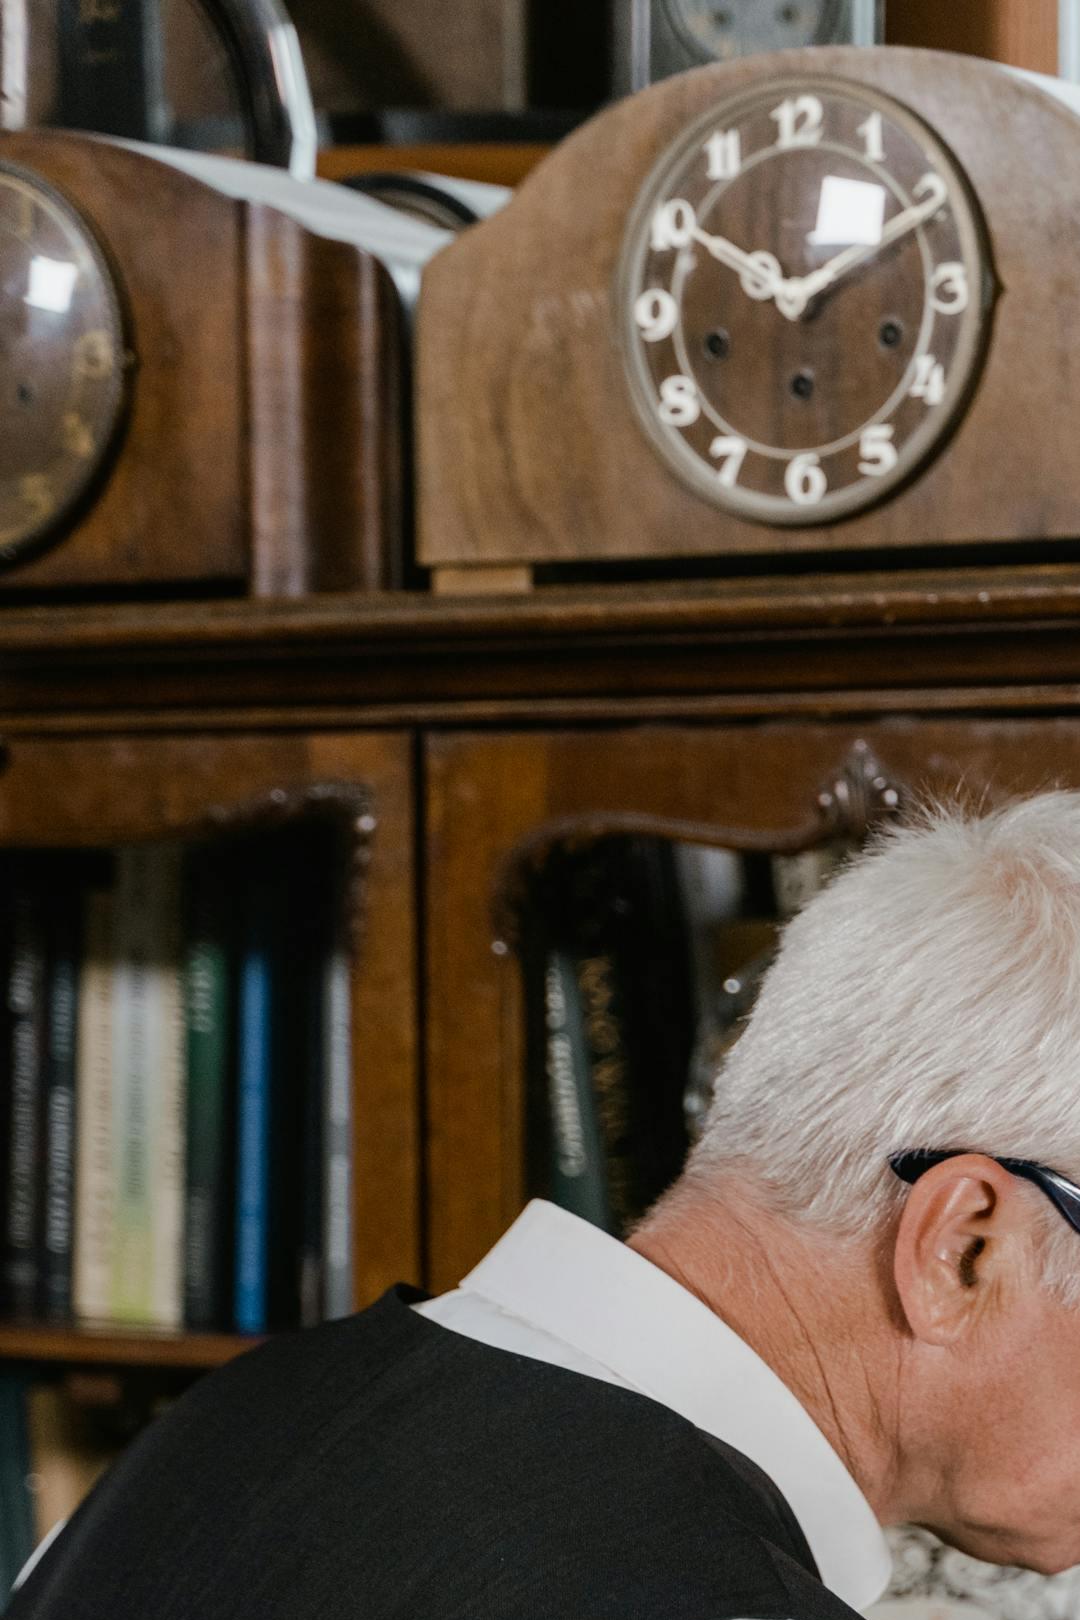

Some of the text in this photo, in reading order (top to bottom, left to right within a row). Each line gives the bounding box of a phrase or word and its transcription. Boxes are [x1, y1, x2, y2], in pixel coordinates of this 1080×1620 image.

[769, 94, 823, 148] 12
[856, 111, 885, 162] 1
[703, 128, 741, 181] 11
[651, 198, 697, 252] 10
[634, 287, 678, 342] 9
[929, 261, 968, 315] 3
[658, 374, 700, 427] 8
[909, 354, 945, 406] 4
[709, 435, 747, 488] 7
[857, 423, 898, 477] 5
[784, 452, 827, 507] 6
